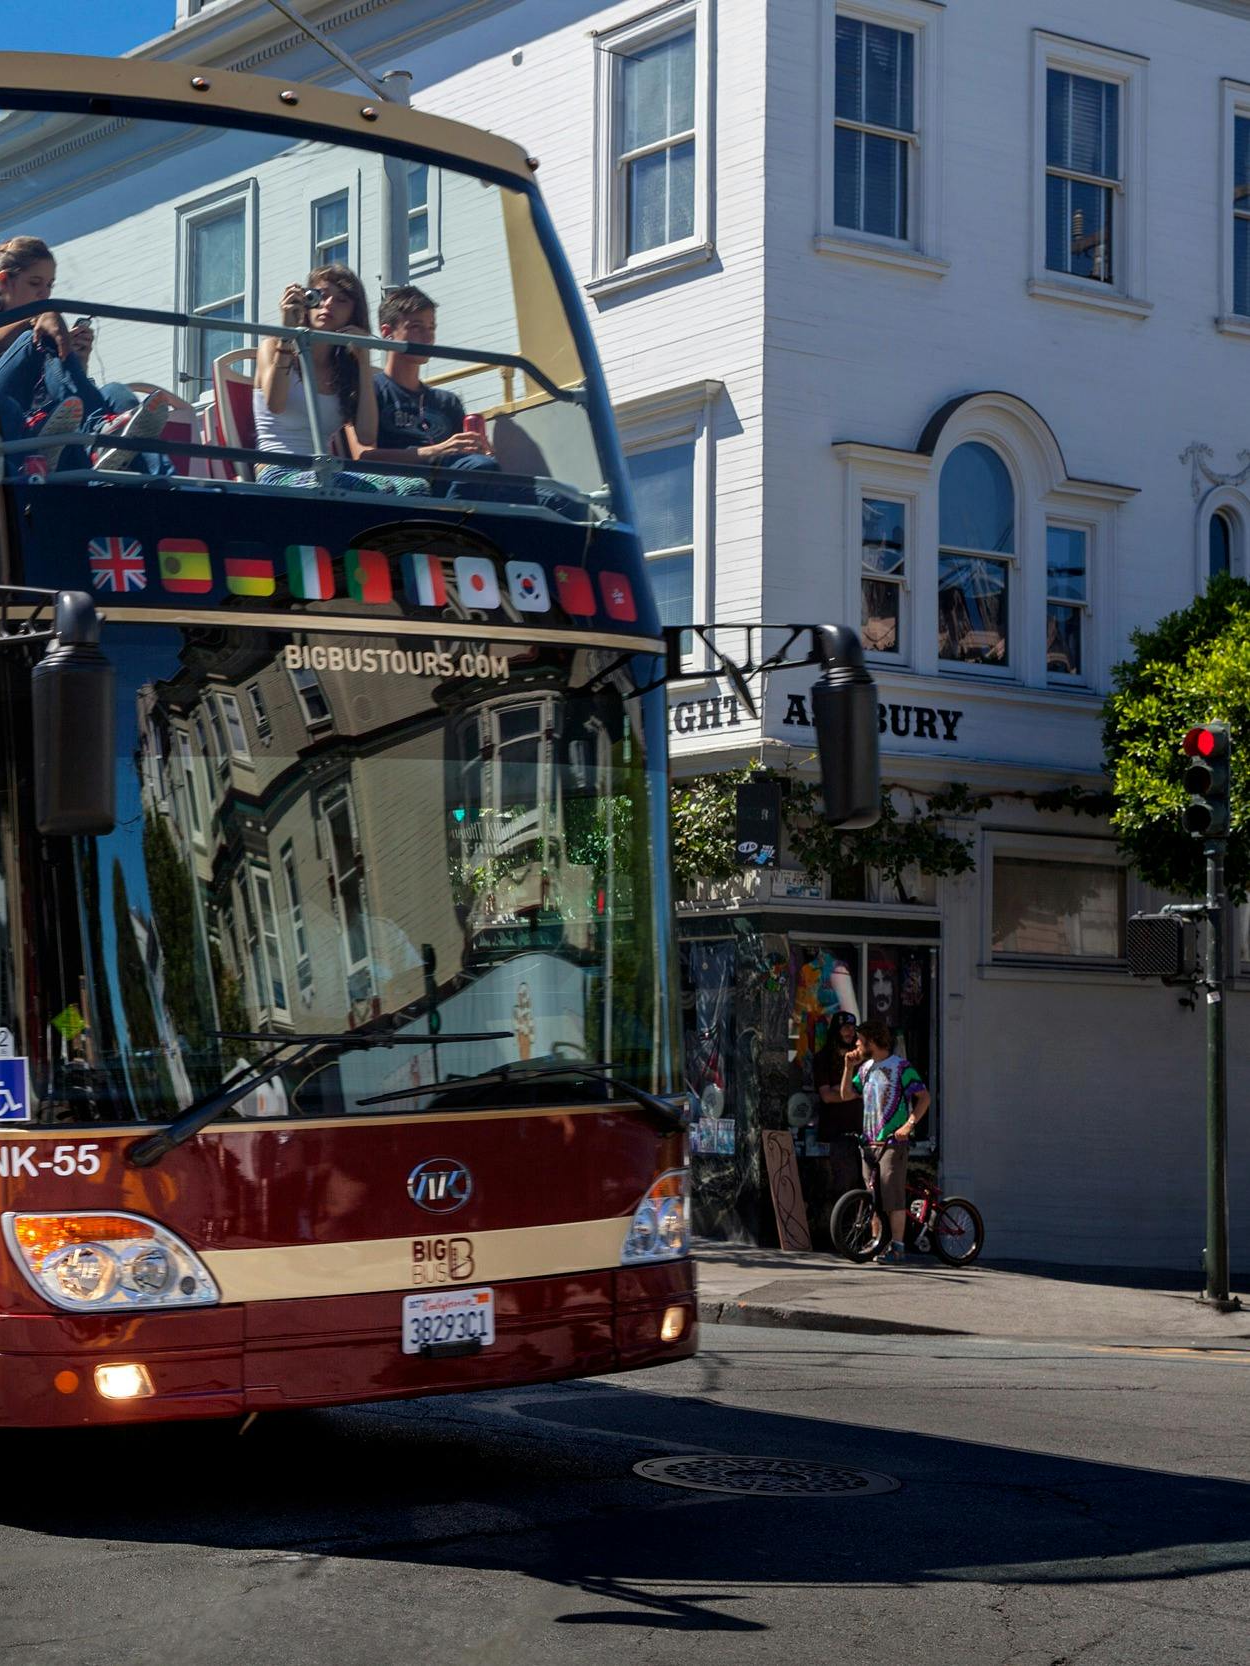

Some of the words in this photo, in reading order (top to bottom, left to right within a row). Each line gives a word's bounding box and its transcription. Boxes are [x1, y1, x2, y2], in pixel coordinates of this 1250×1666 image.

[284, 644, 510, 679] BIGBUSTOURS.COM
[668, 695, 741, 735] GHT
[783, 694, 963, 741] AURY
[413, 1239, 446, 1262] BIG
[413, 1262, 447, 1284] BUS
[410, 1310, 488, 1344] 38293C1
